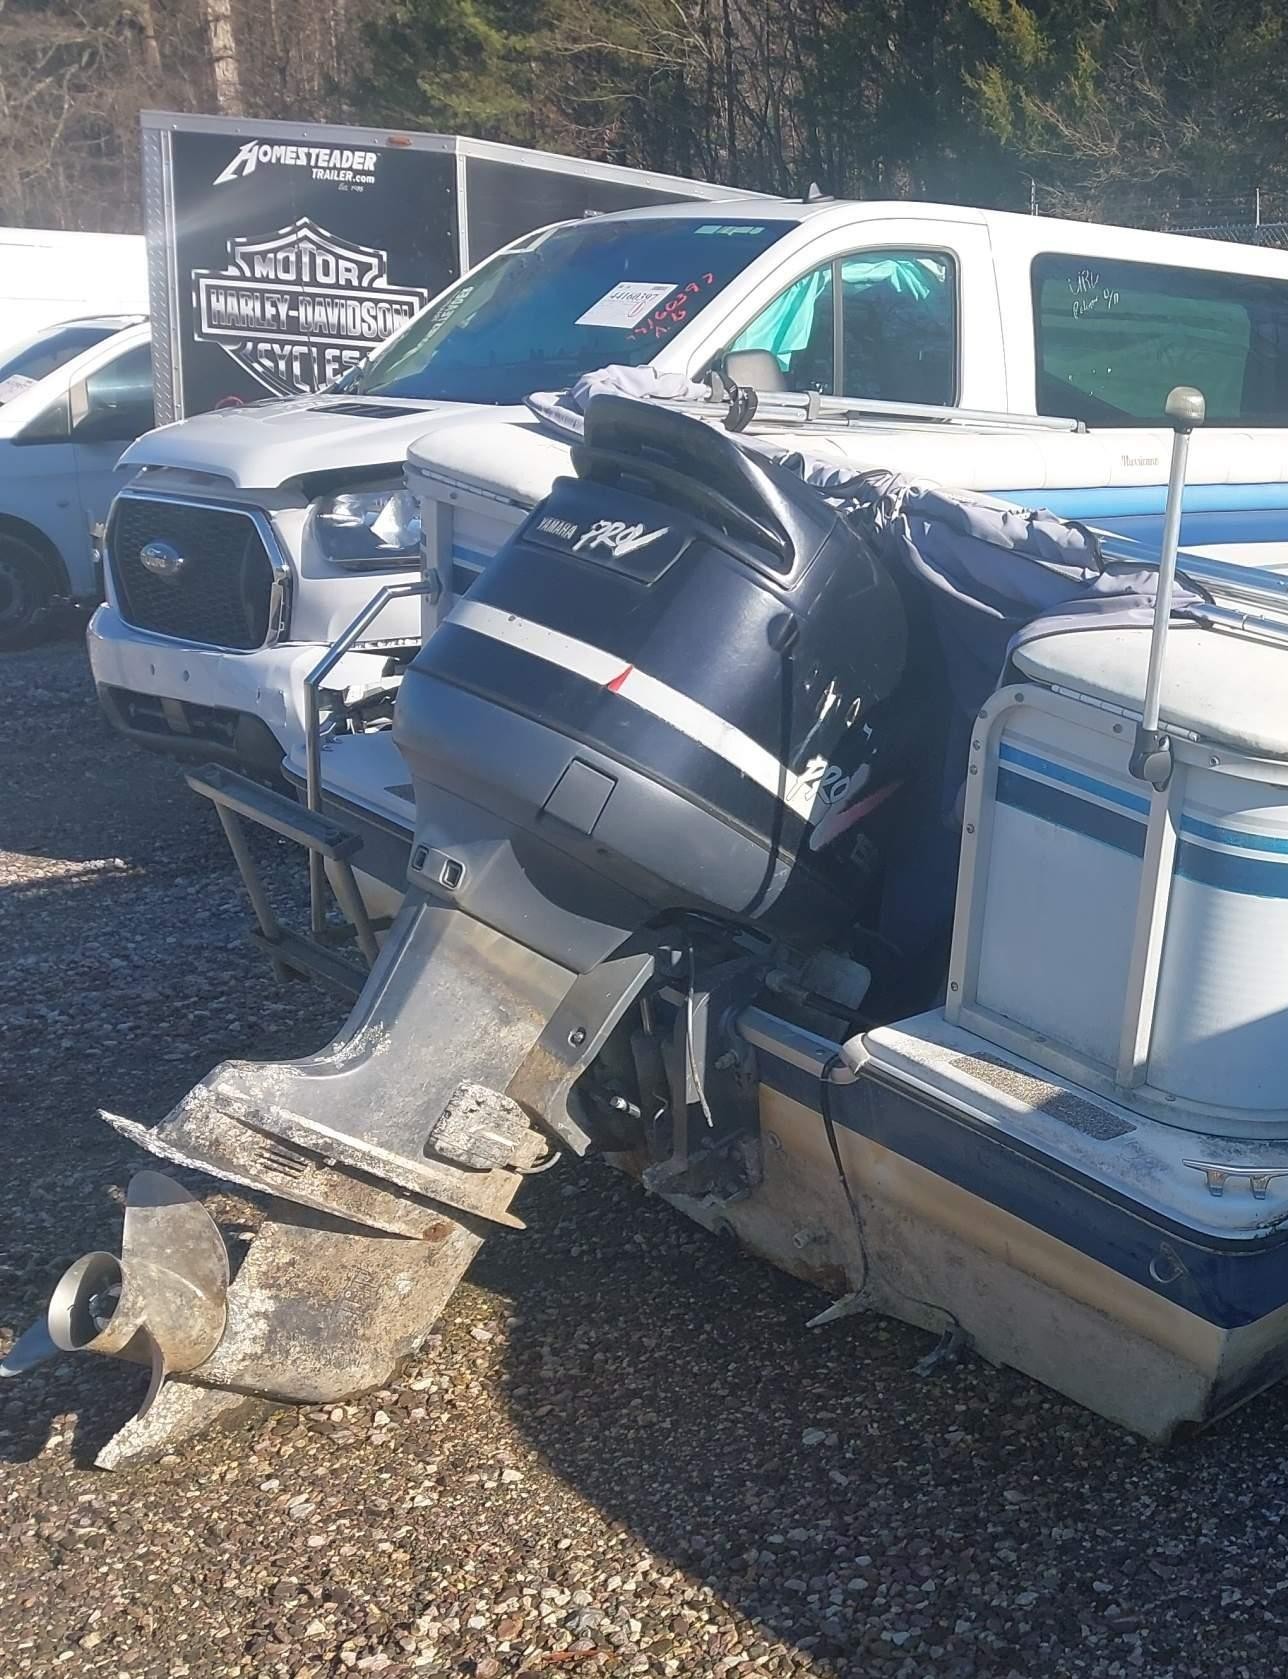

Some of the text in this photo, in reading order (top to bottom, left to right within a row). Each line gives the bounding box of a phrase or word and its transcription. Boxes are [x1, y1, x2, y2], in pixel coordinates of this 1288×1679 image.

[212, 139, 378, 186] HOMESTEADER
[311, 168, 375, 184] TRAILER.com
[254, 242, 359, 286] MOTOR
[210, 288, 409, 339] HARLEY-DAVIDSON
[537, 518, 578, 539] YAMAHA
